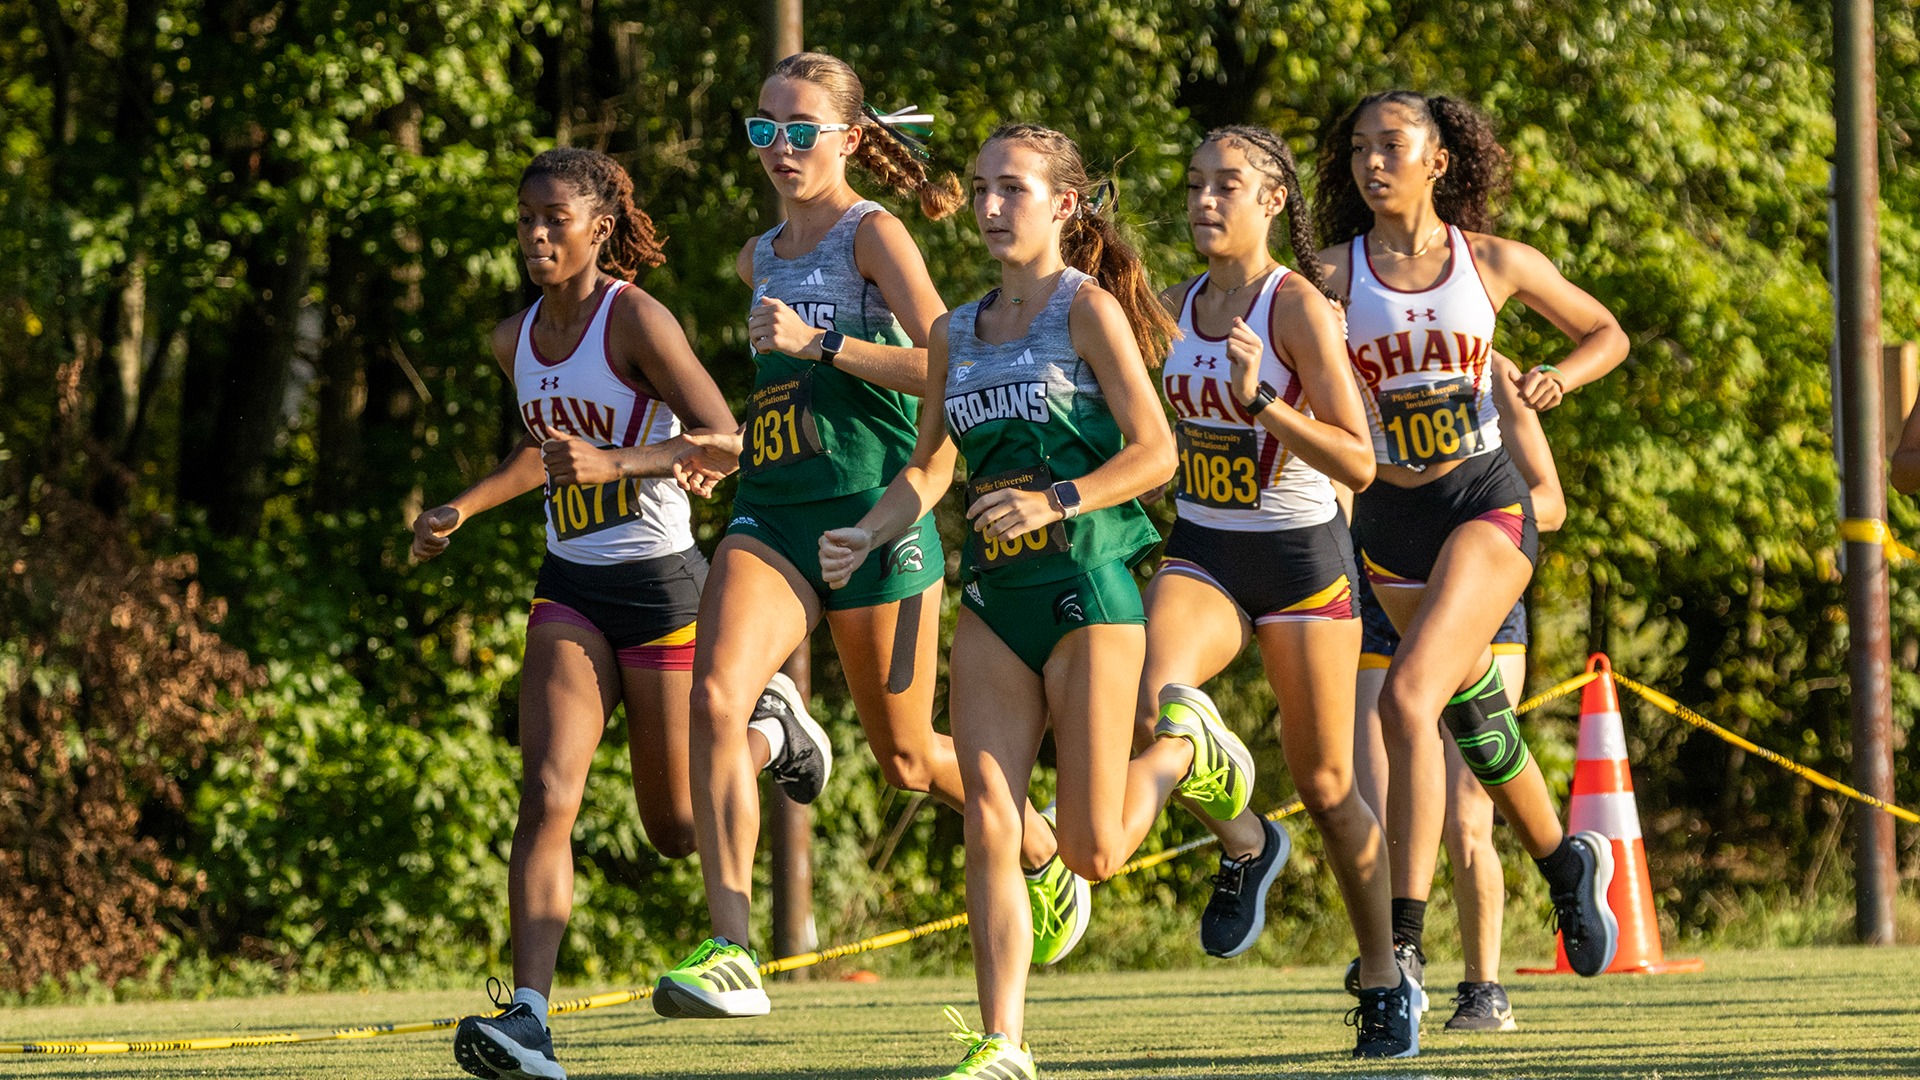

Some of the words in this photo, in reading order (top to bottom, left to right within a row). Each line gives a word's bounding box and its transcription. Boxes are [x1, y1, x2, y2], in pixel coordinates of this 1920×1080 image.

[1356, 329, 1492, 388] SHAW
[767, 380, 800, 394] University
[944, 381, 1051, 437] TROJANS
[1405, 393, 1450, 410] Invitational
[1420, 383, 1460, 398] University
[753, 404, 800, 466] 931
[1203, 431, 1241, 444] University
[1387, 402, 1477, 461] 1081
[994, 474, 1034, 489] University
[1180, 449, 1258, 504] 1083
[552, 478, 629, 533] 1077
